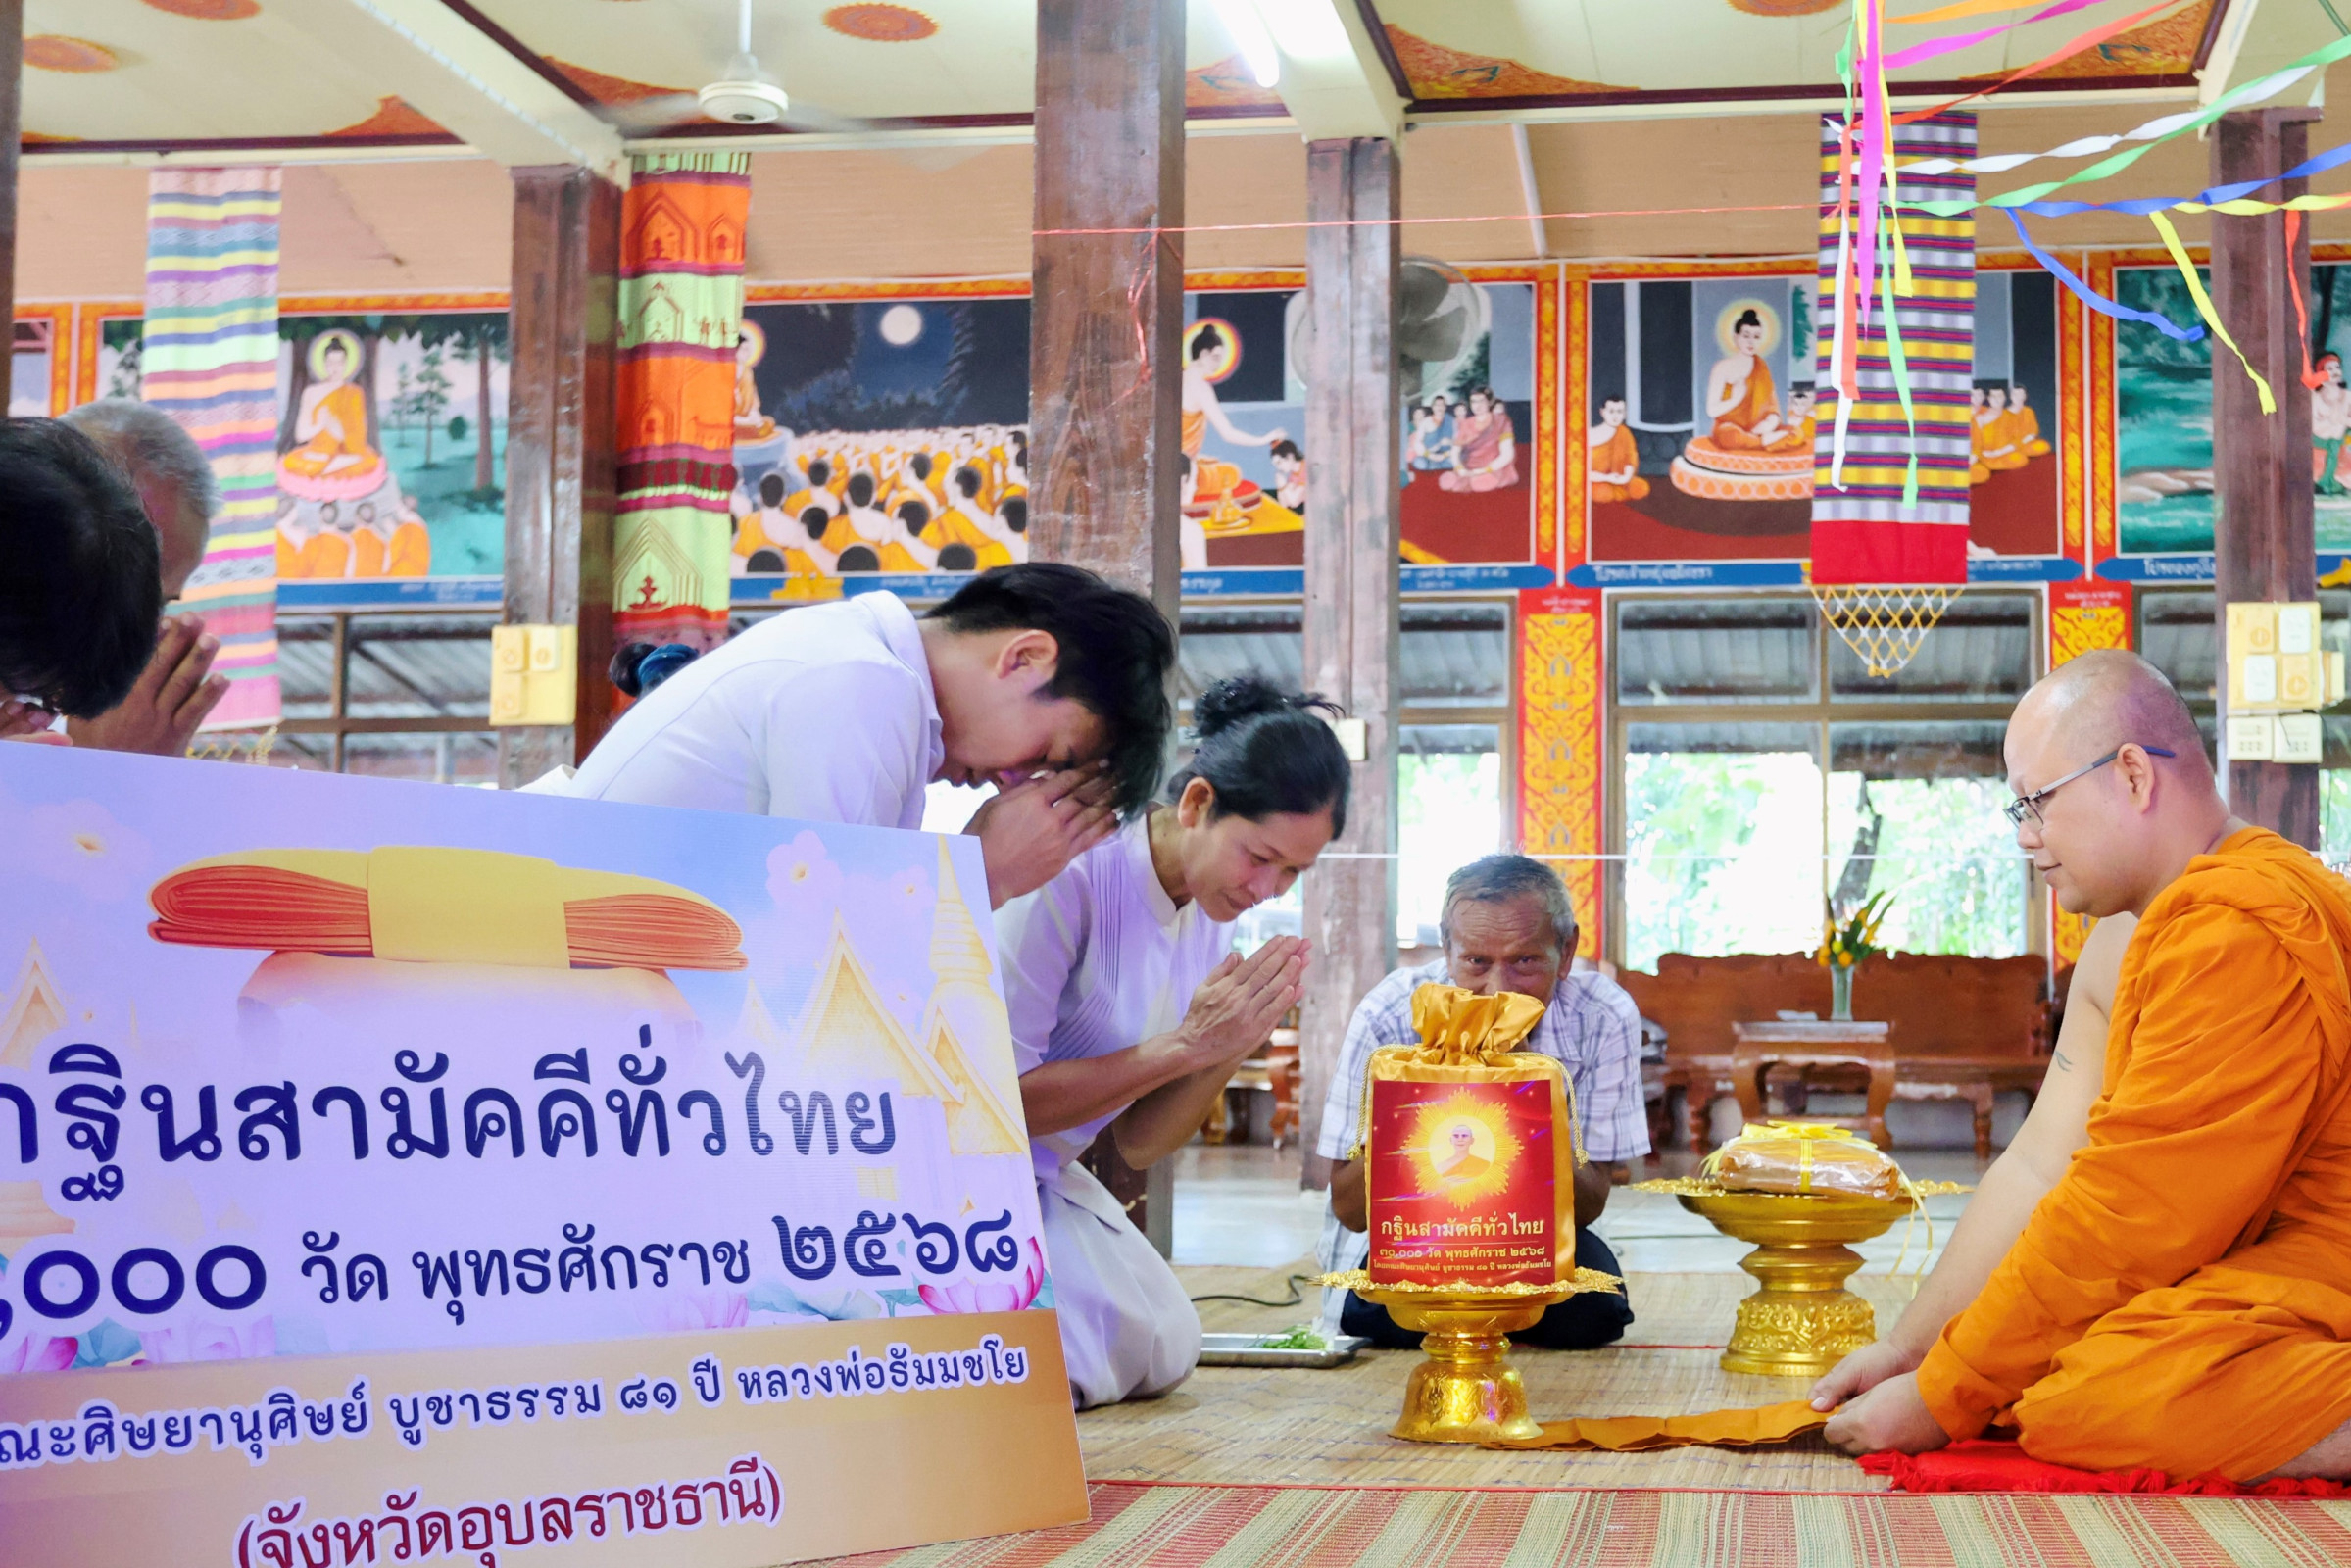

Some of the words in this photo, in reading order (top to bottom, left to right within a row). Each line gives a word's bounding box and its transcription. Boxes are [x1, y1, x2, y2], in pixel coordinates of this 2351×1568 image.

[301, 1230, 389, 1304] วัด
[411, 1222, 751, 1326] พุทธศักราช
[771, 1208, 1019, 1281] ๒๕๖๘
[1426, 1246, 1442, 1258] วัด
[1445, 1246, 1507, 1262] พุทธศักราช
[1510, 1246, 1545, 1257] ๒๕๖๘
[389, 1384, 601, 1446] บูชาธรรม
[620, 1379, 677, 1409] ๘๑
[692, 1358, 720, 1403] ปี
[737, 1339, 1025, 1399] หลวงพ่อธัมมชโย
[238, 1457, 780, 1568] (จังหวัดอุบลราชธานี)
